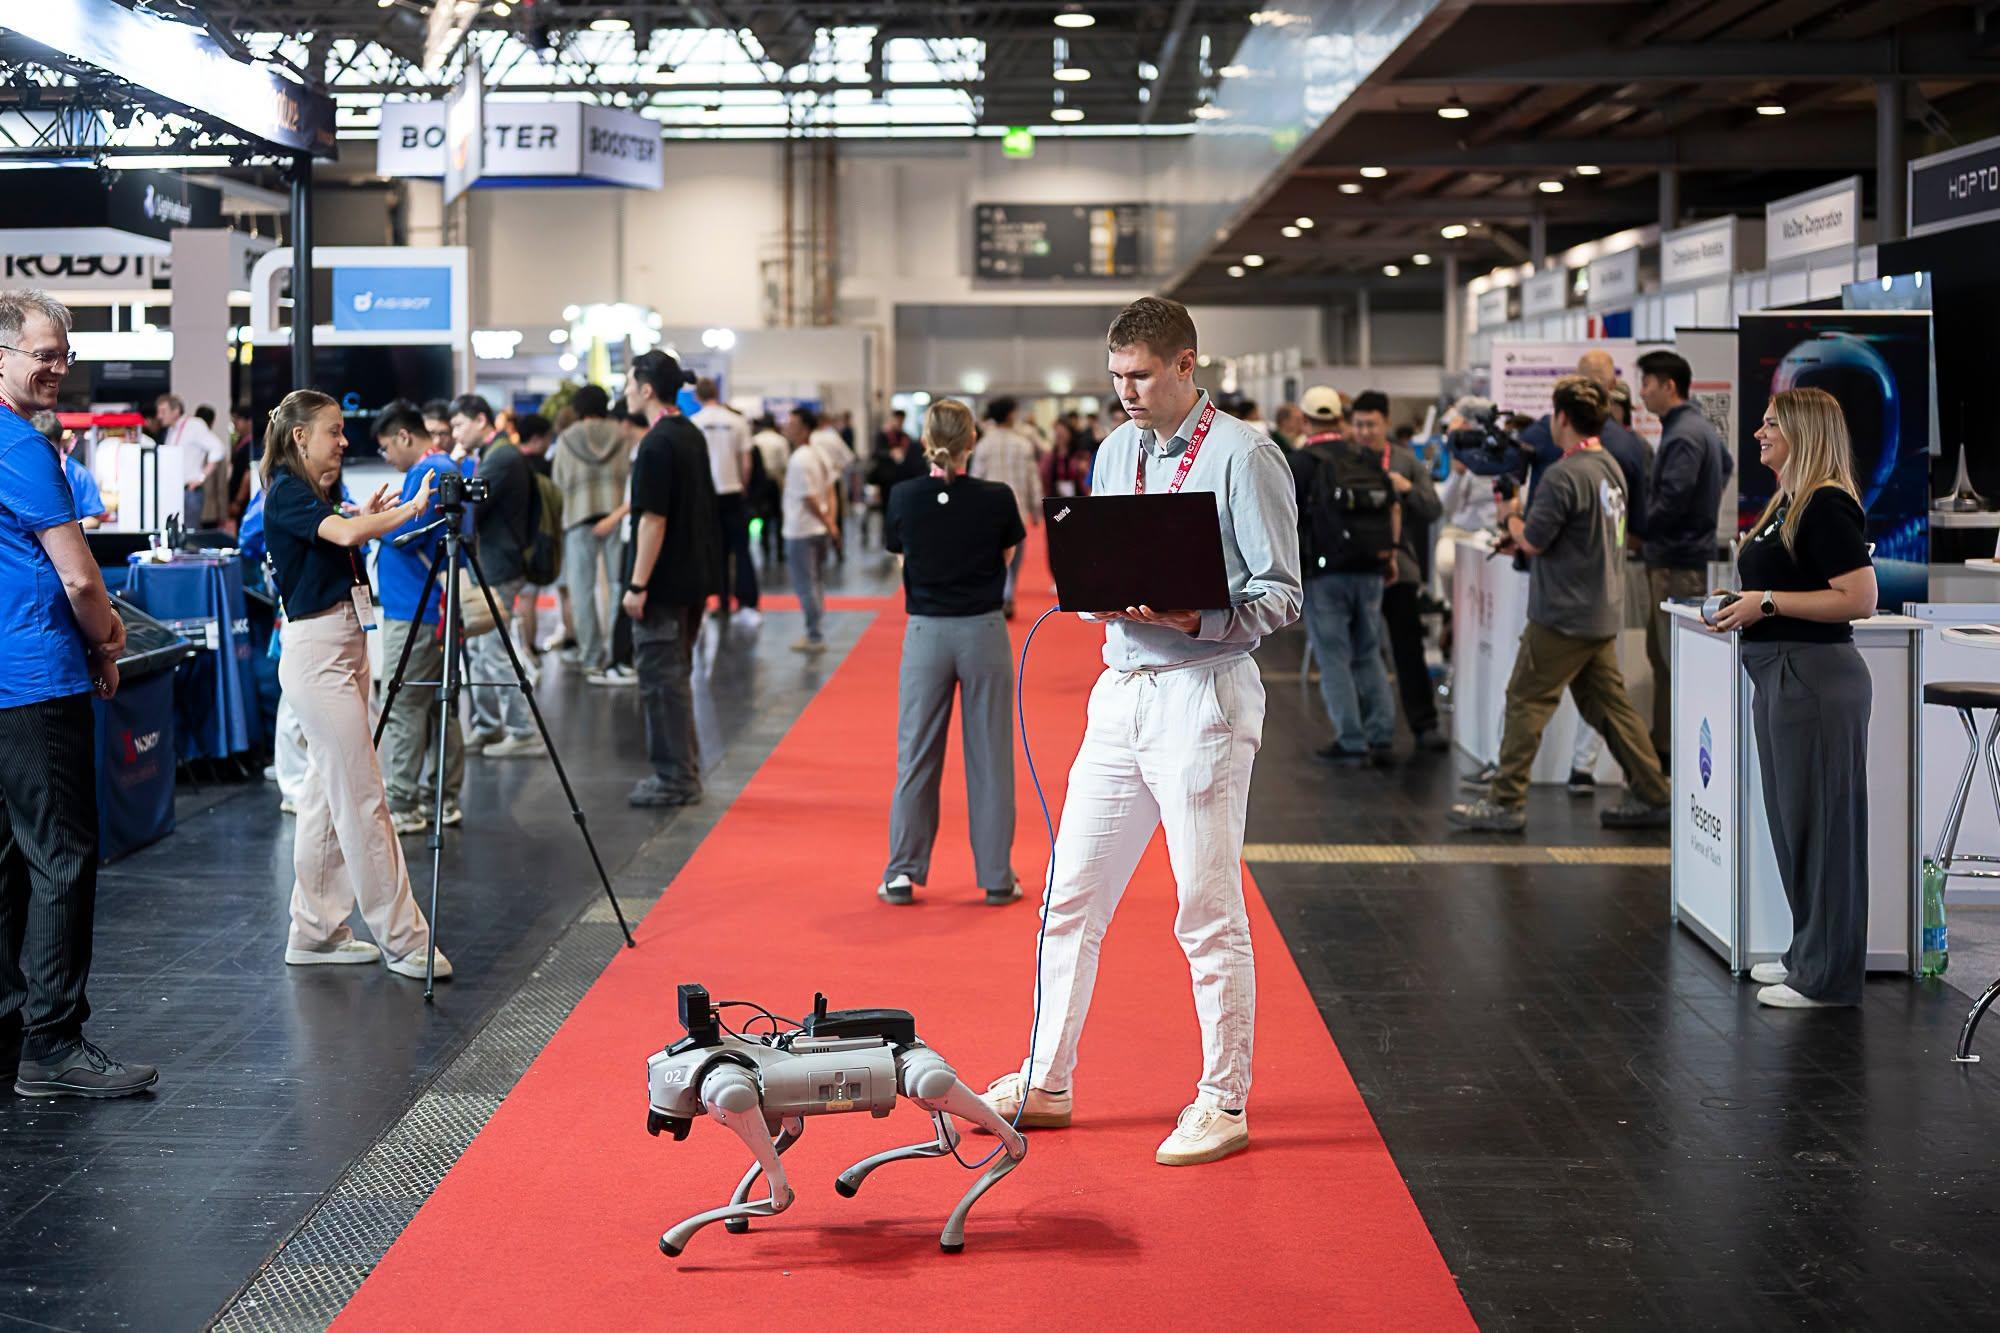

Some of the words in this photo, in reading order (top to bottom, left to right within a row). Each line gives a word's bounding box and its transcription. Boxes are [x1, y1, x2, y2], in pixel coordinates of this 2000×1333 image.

[401, 125, 559, 149] BOTER
[590, 126, 655, 162] BOOSTER
[1948, 165, 1999, 200] HOPTO
[1804, 210, 1843, 236] Corporation
[1186, 434, 1200, 454] ICRA
[1690, 792, 1722, 842] Resense
[664, 1069, 681, 1083] 02
